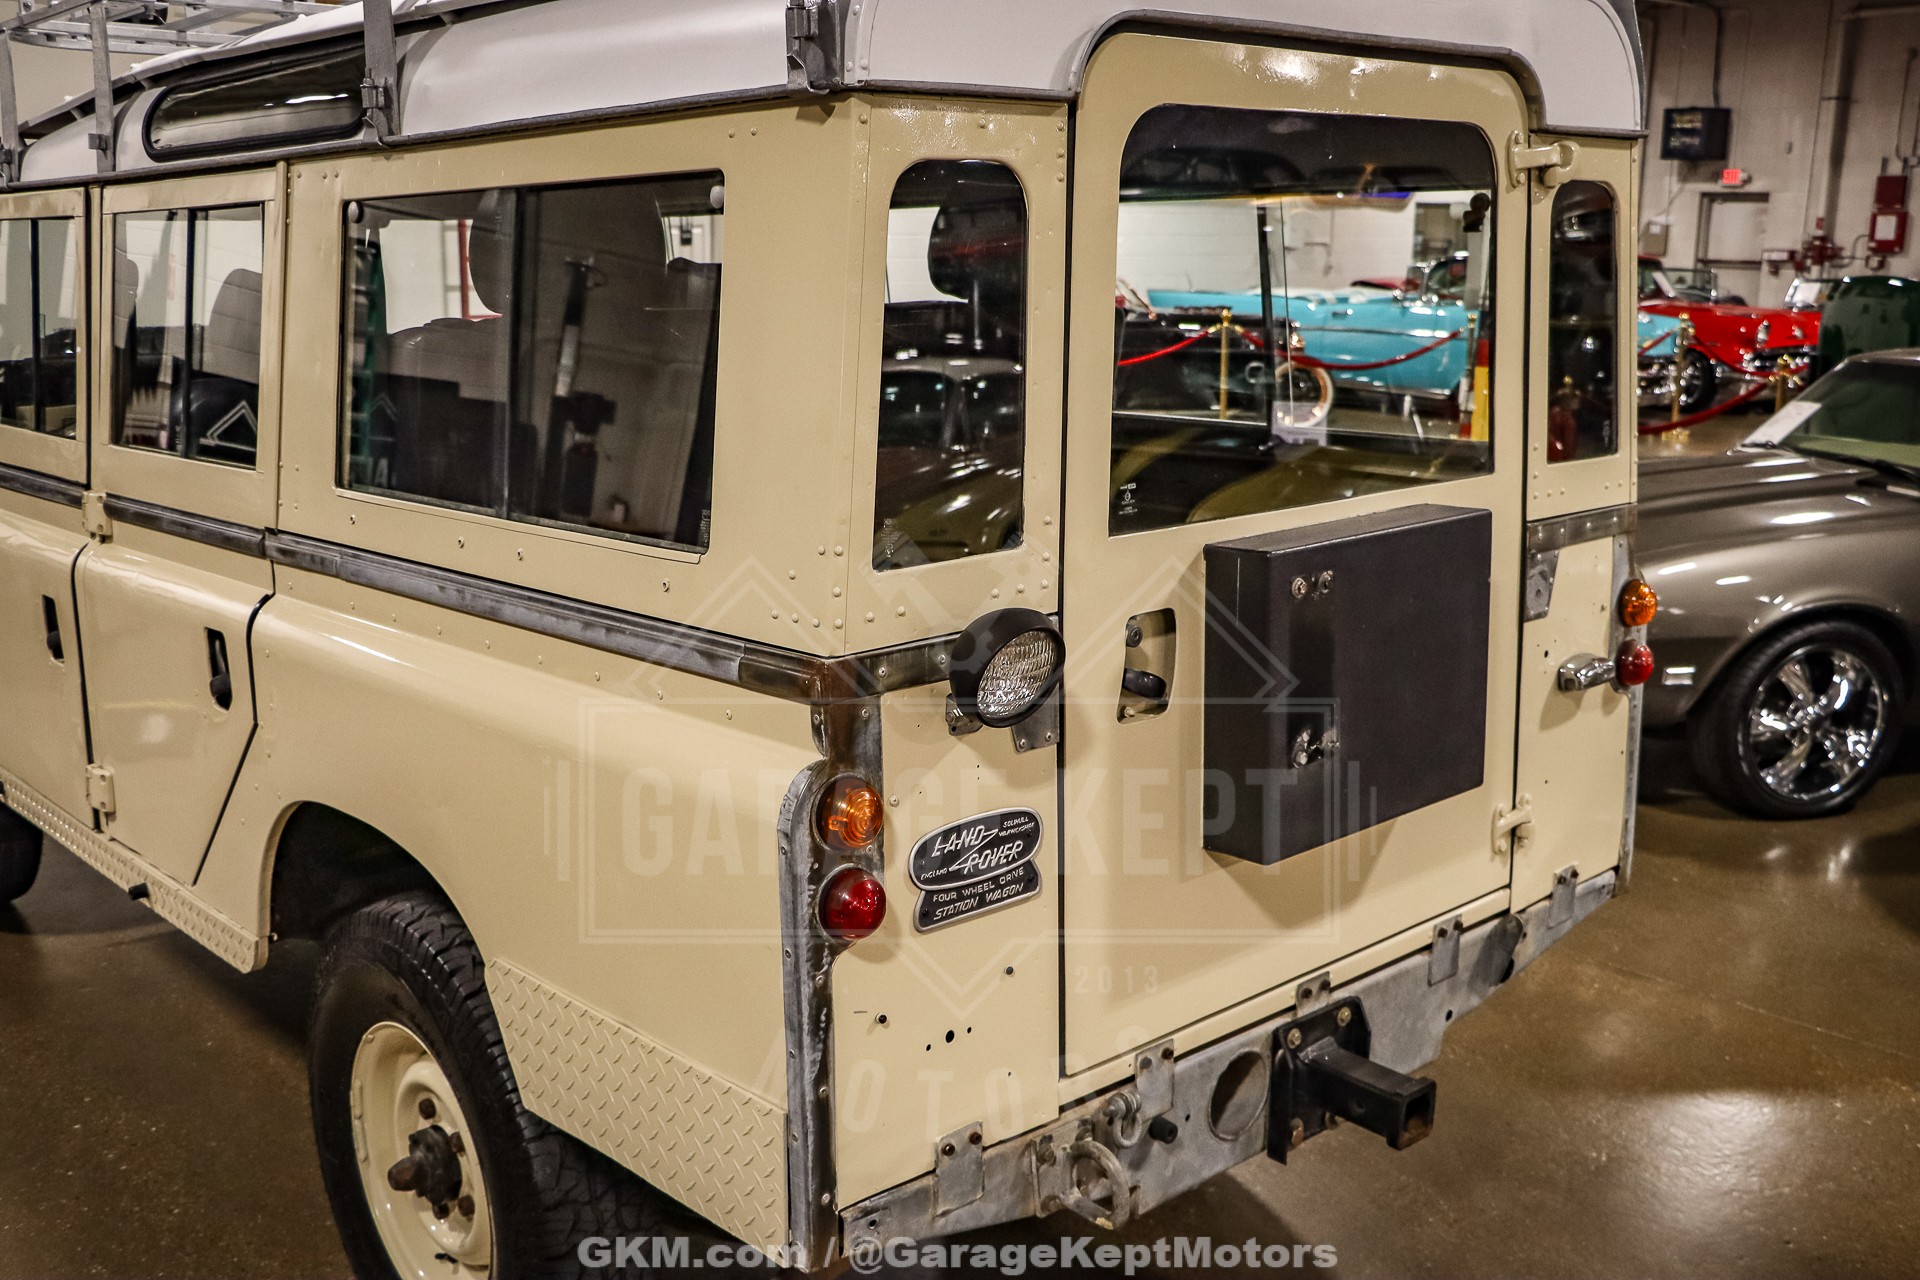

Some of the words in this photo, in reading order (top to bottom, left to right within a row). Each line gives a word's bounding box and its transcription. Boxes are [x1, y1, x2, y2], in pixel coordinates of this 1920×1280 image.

[931, 825, 986, 857] LAND
[963, 840, 1024, 874] ROVER
[920, 868, 948, 880] ENGLAND
[933, 891, 958, 902] FOUR
[962, 881, 995, 897] WHEEL
[999, 866, 1024, 885] DRIVE
[933, 896, 979, 920] STATION
[986, 883, 1024, 902] WAGON
